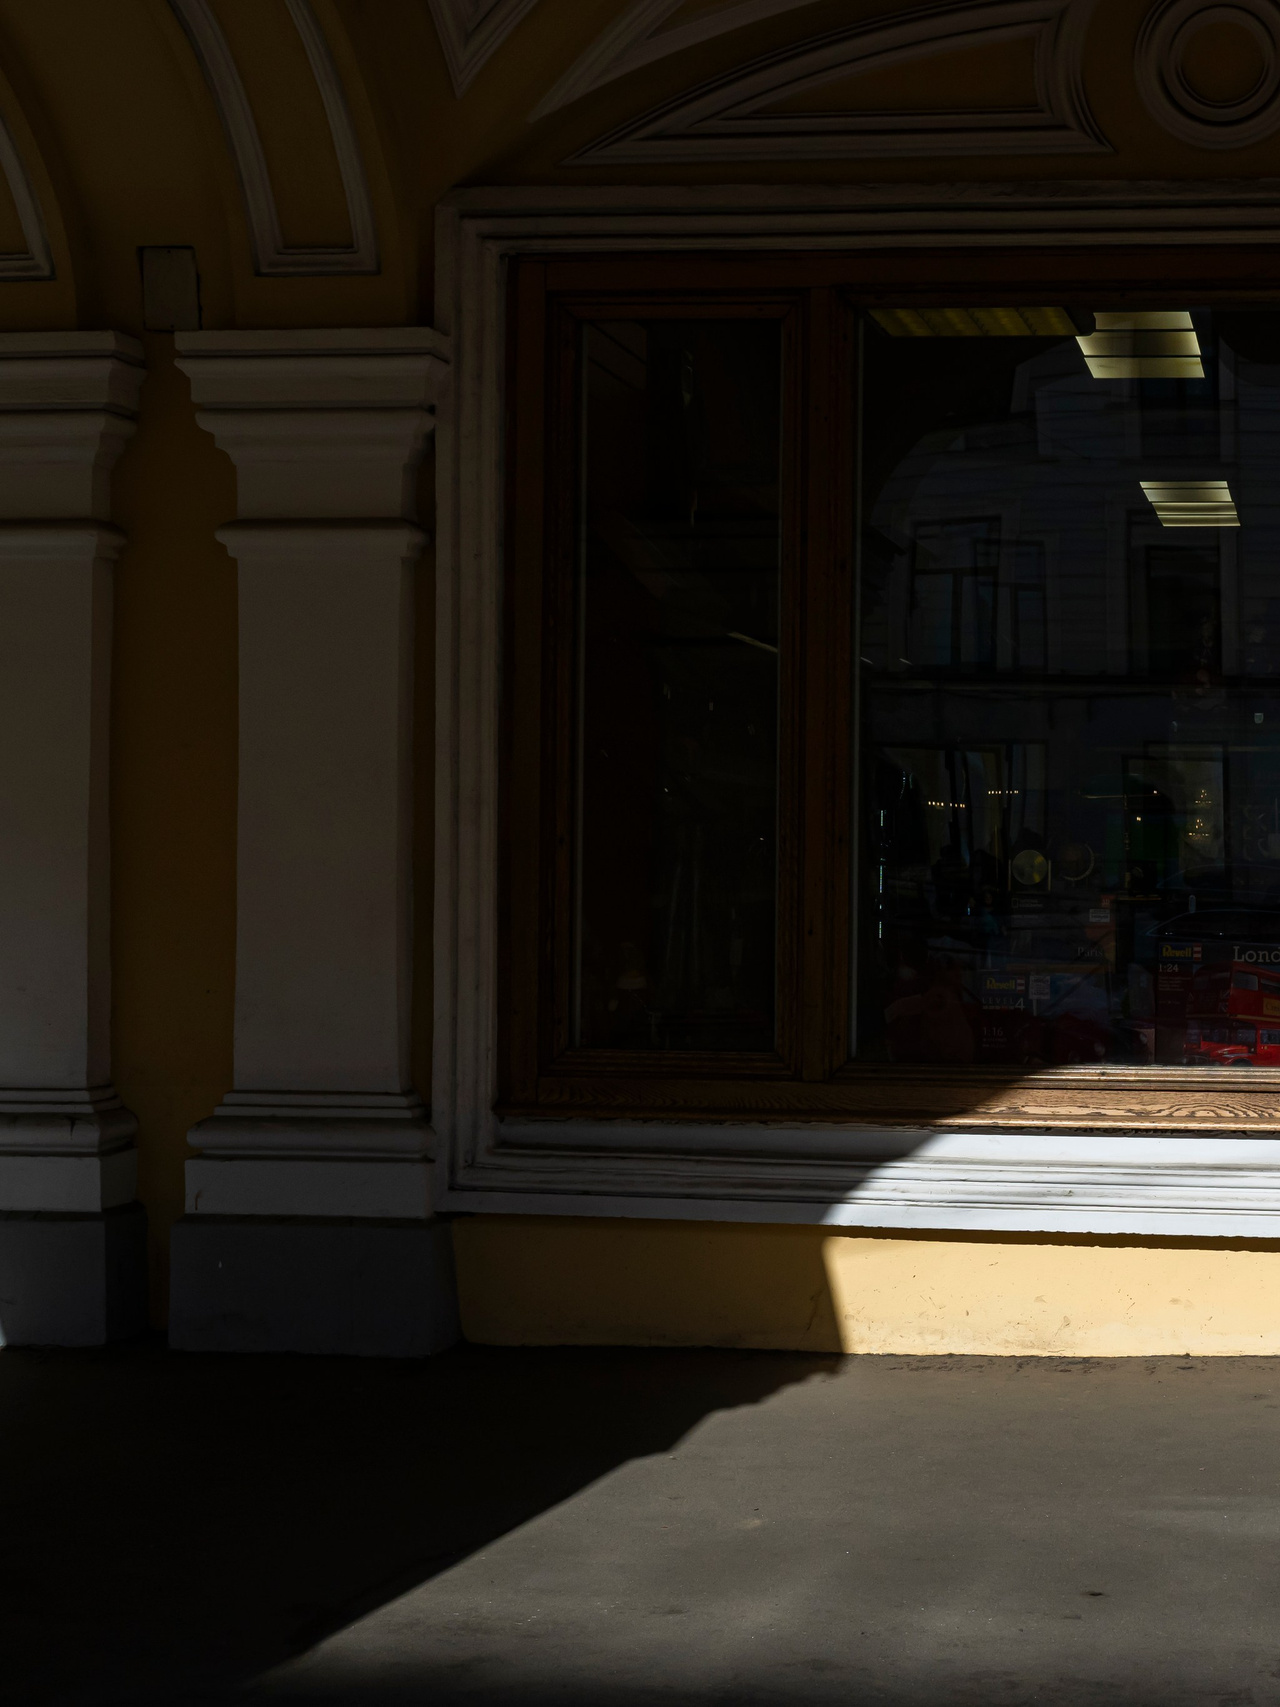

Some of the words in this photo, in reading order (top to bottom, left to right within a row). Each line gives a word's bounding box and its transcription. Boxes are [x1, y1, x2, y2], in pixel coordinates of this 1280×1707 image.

[1077, 946, 1103, 957] Paris
[1161, 944, 1191, 957] Revell
[1159, 963, 1179, 973] 1:24
